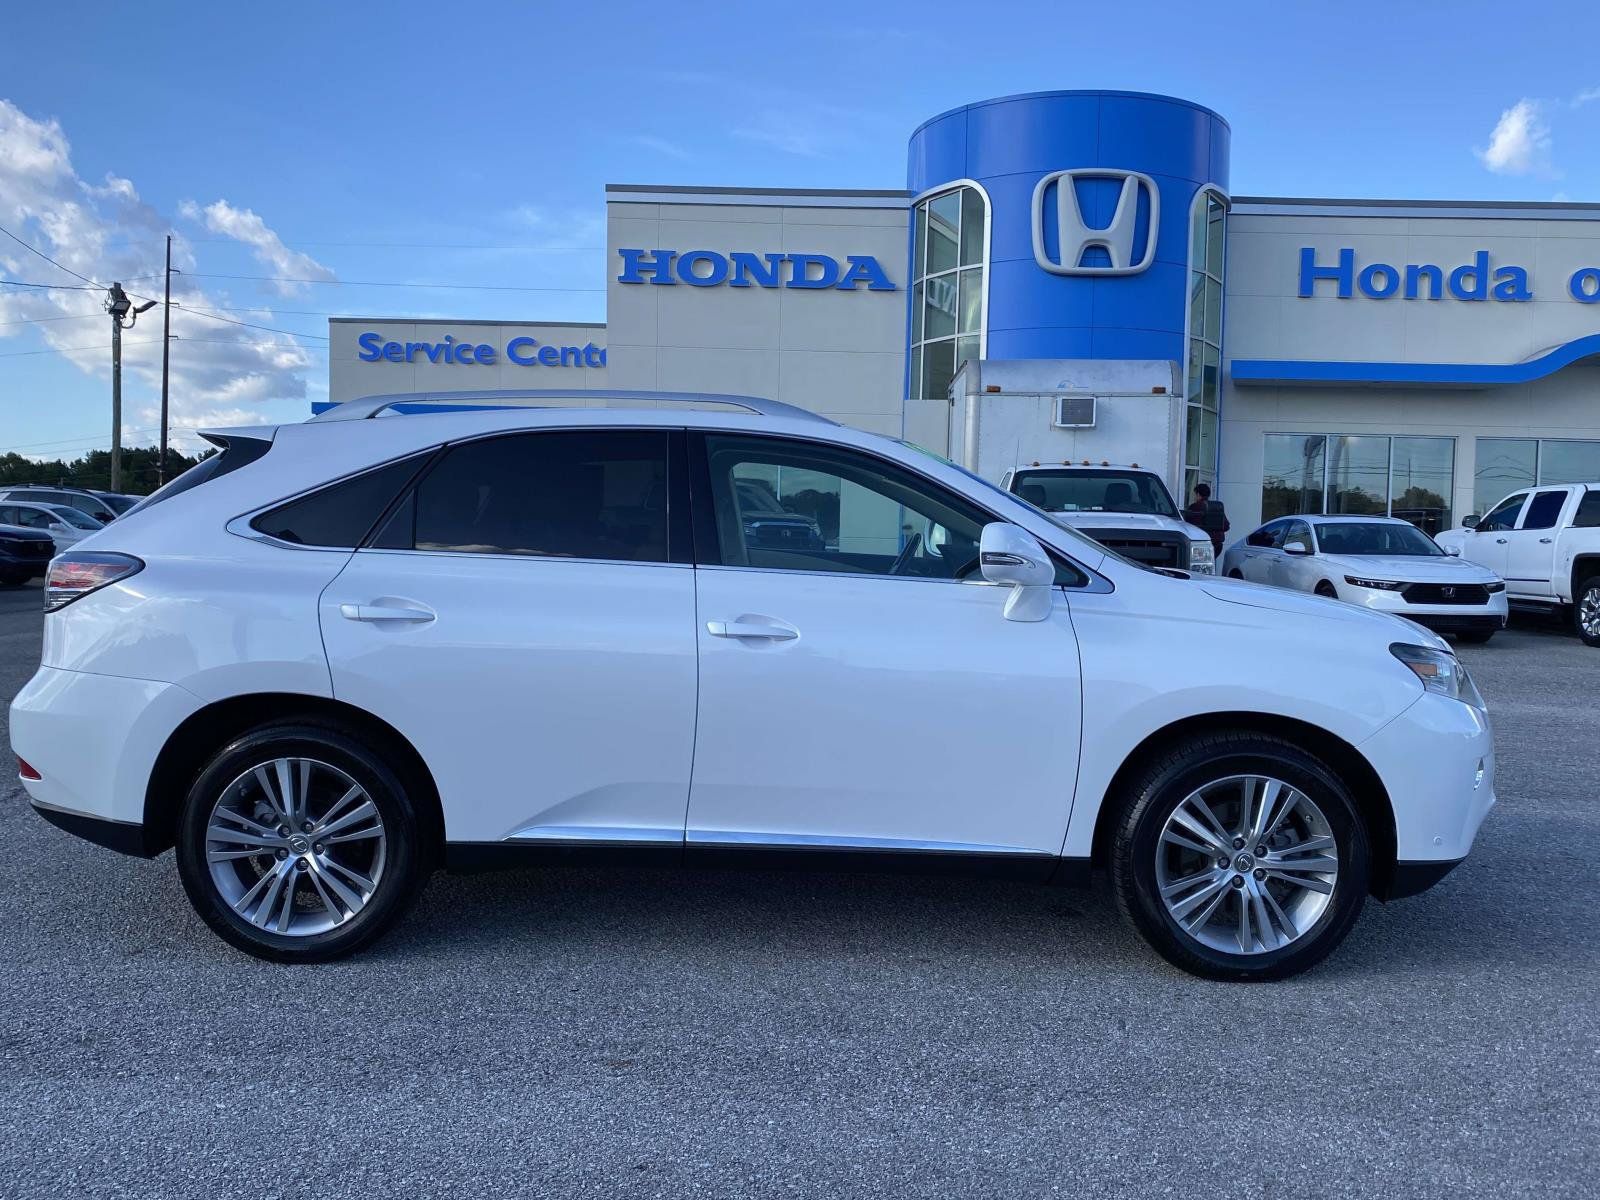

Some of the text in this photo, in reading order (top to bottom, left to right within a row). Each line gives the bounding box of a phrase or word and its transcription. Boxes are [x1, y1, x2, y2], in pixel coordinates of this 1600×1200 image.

[618, 248, 896, 291] HONDA
[1298, 247, 1533, 302] Honda
[357, 332, 606, 367] Service Cent
